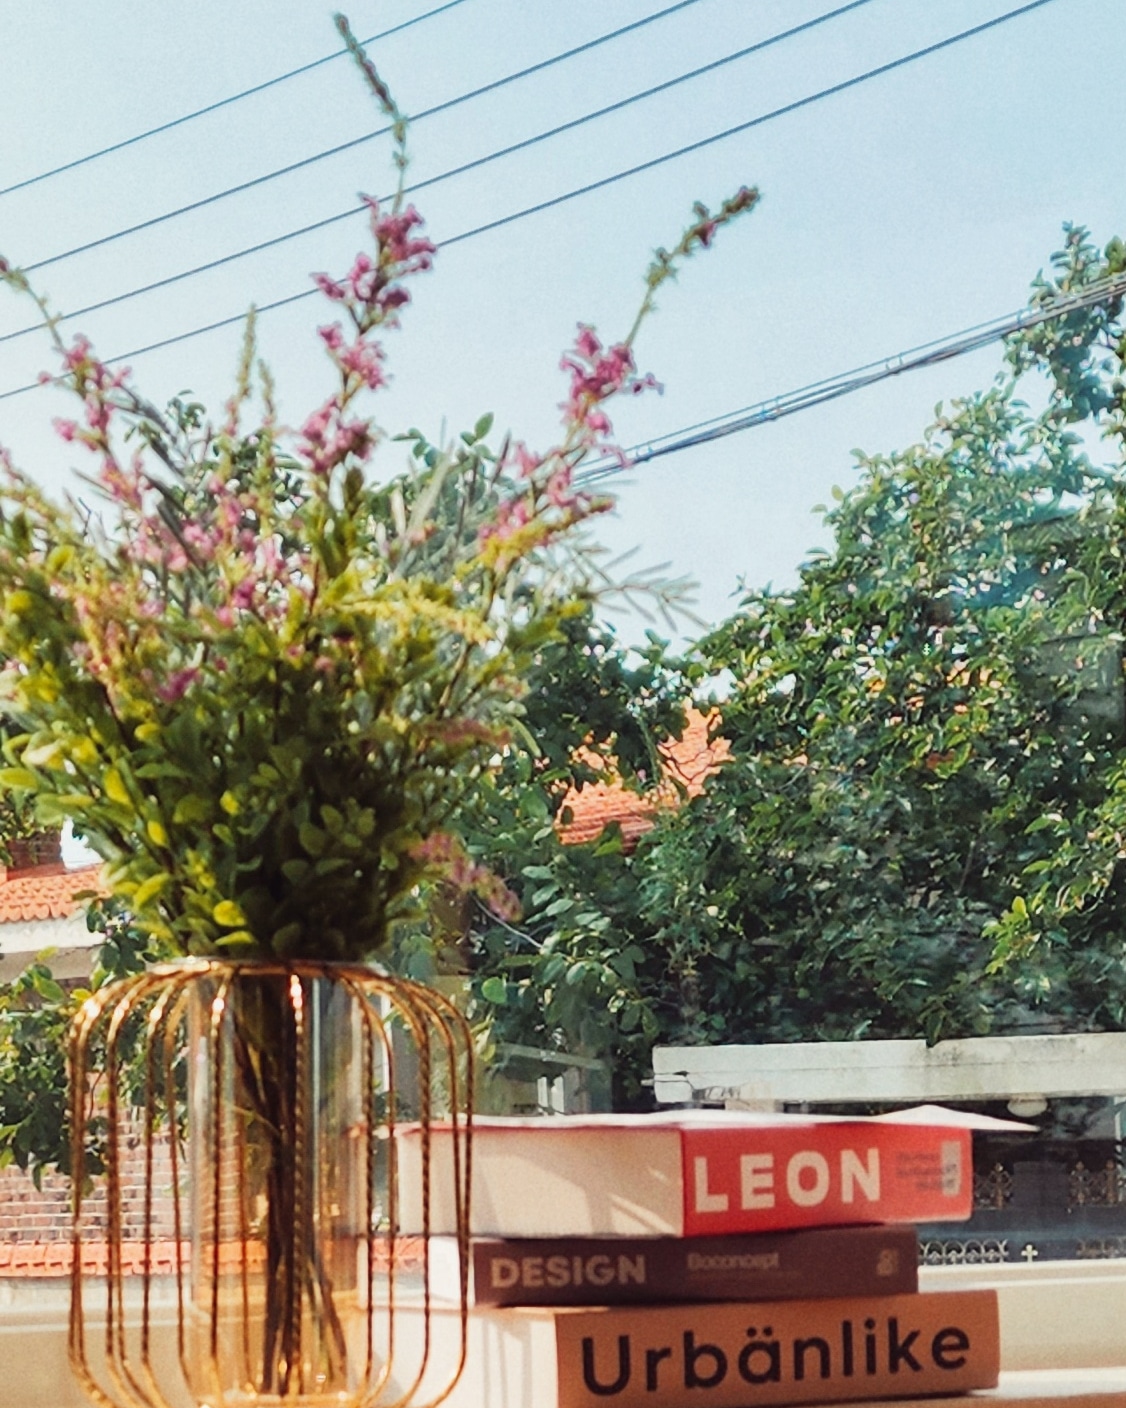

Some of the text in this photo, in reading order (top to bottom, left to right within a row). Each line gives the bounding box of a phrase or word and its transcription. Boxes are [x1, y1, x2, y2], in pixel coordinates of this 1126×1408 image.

[694, 1147, 881, 1213] LEON
[490, 1253, 646, 1288] DESIGN
[580, 1316, 970, 1395] Urbänlike
